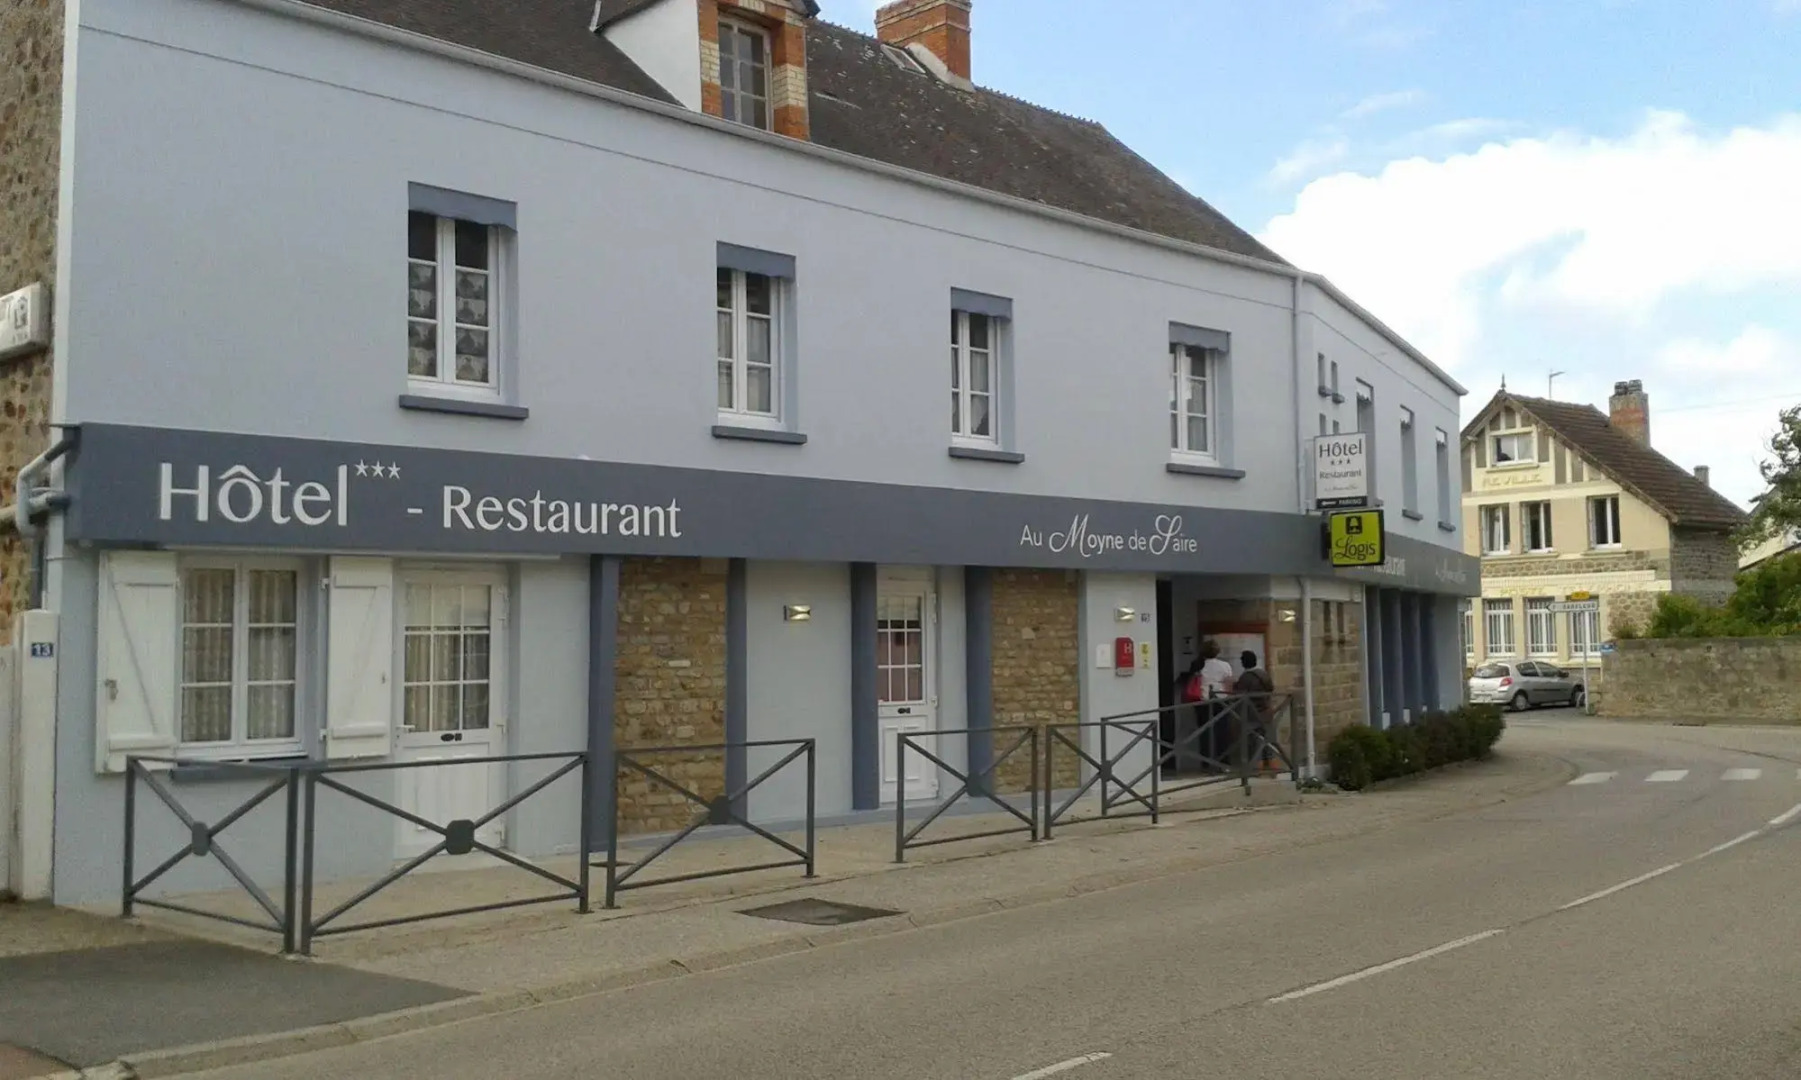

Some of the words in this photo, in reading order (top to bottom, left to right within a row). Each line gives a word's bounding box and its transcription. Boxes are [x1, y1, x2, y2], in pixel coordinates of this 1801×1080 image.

[1319, 439, 1363, 458] Hôtel
[1319, 469, 1362, 479] Restaurant
[159, 462, 348, 526] Hôtel
[443, 485, 682, 538] Restaurant
[1020, 525, 1043, 547] Au
[1049, 514, 1124, 558] Moyne
[1128, 529, 1147, 551] de
[1334, 536, 1376, 561] Logis
[34, 644, 51, 657] 13
